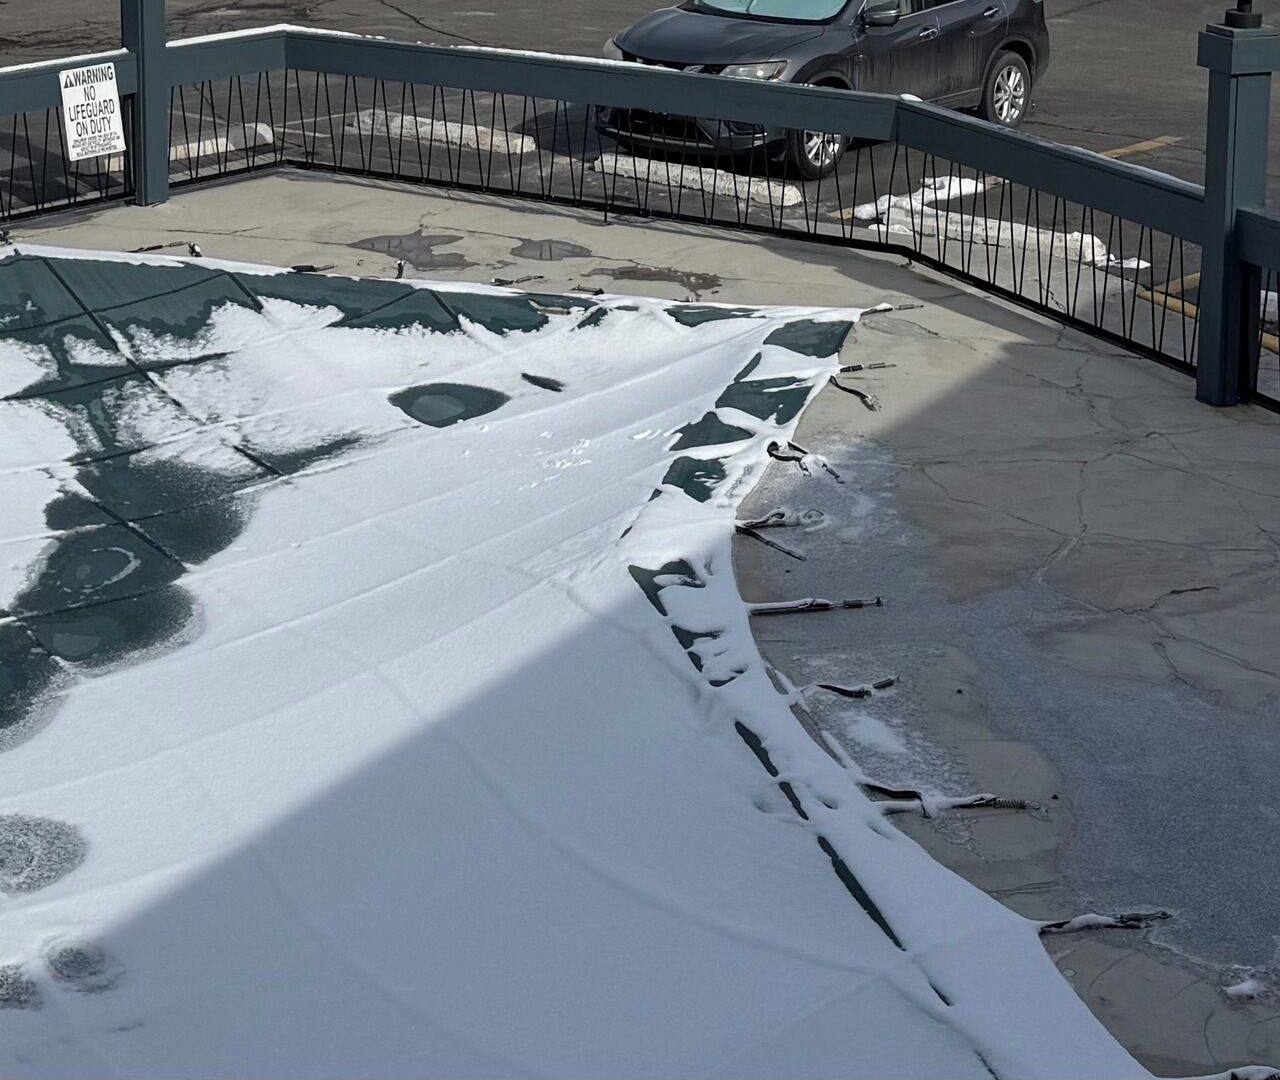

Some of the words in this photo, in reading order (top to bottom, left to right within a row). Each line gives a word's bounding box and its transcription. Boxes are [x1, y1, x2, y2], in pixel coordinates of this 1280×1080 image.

[73, 65, 114, 87] WARNING
[83, 85, 96, 102] NO
[68, 99, 115, 122] LIFEGUARD
[76, 121, 89, 138] ON
[90, 116, 112, 135] DUTY
